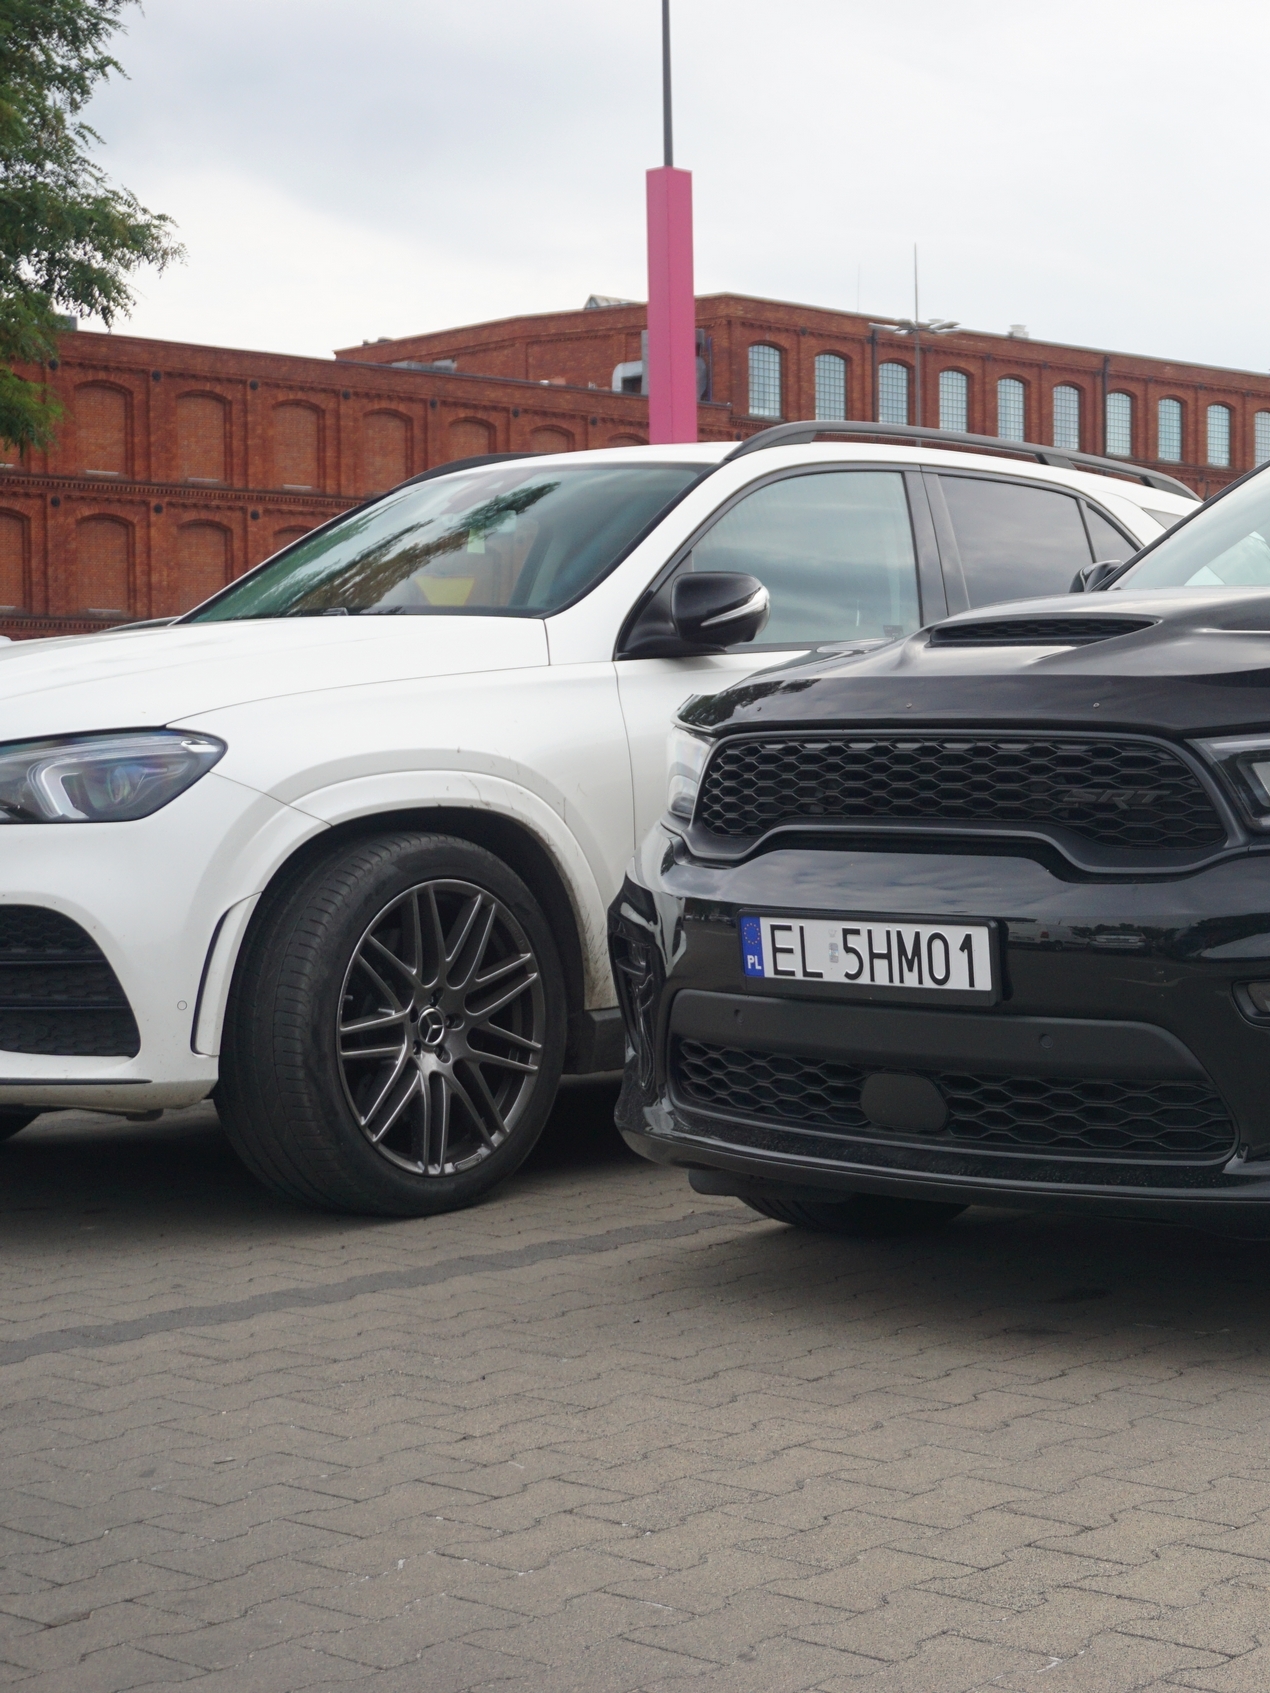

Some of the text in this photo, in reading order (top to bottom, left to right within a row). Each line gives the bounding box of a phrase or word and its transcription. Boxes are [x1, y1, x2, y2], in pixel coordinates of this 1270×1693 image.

[1063, 788, 1172, 811] SRT
[747, 954, 762, 970] PL
[769, 923, 976, 988] EL 5HM01
